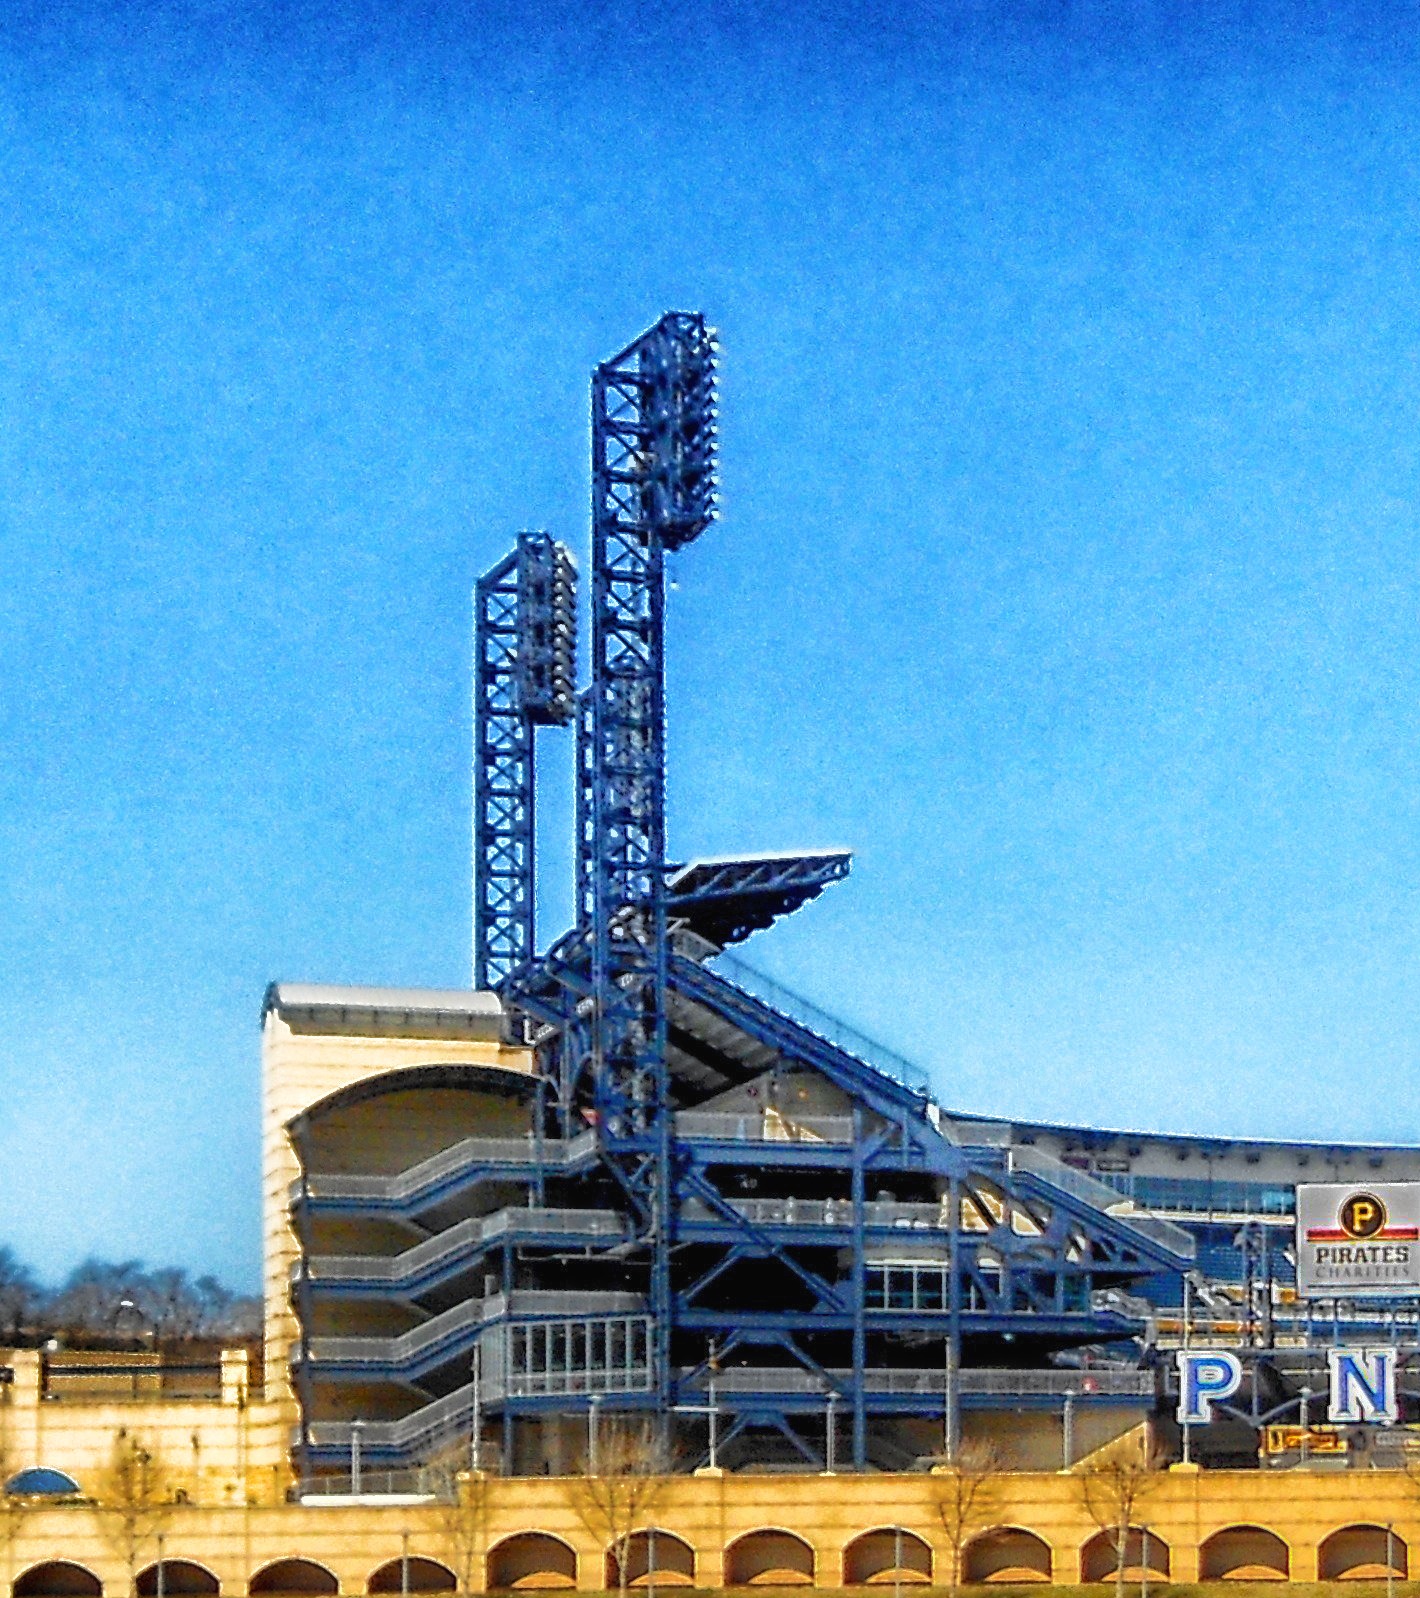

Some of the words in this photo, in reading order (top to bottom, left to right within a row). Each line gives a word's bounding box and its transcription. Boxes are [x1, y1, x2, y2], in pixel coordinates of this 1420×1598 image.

[1352, 1201, 1374, 1232] P
[1315, 1245, 1410, 1264] PIRATES
[1315, 1264, 1410, 1279] CHARITIES
